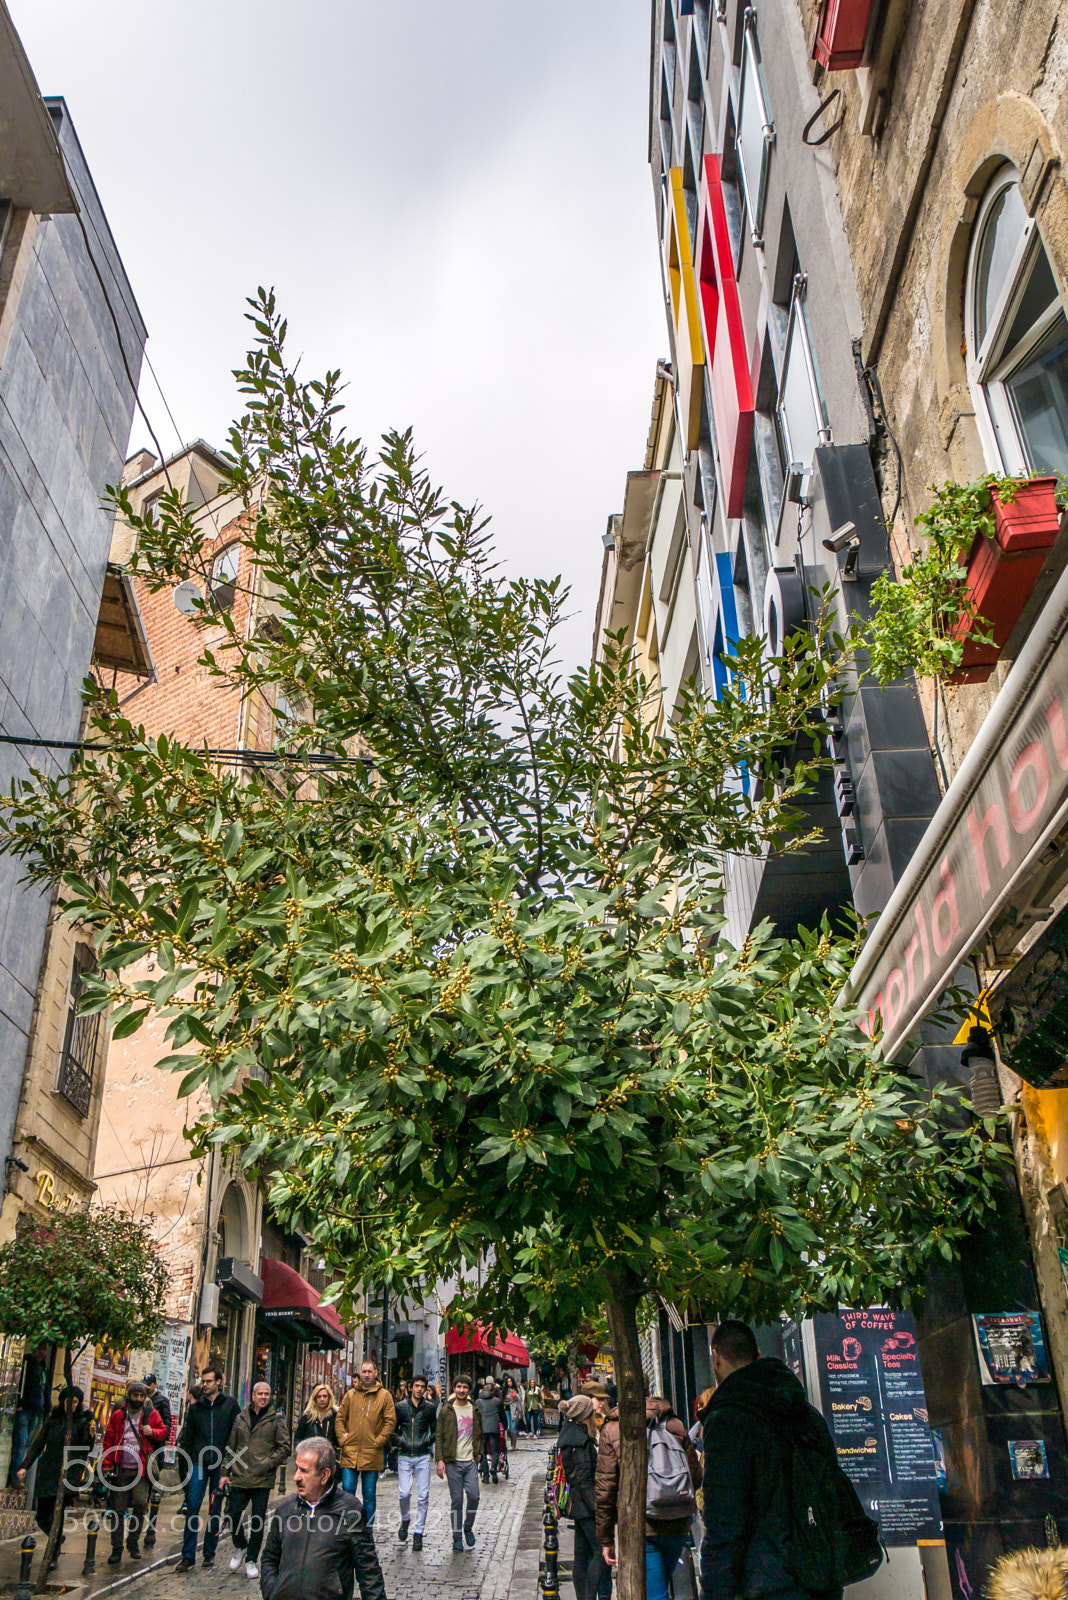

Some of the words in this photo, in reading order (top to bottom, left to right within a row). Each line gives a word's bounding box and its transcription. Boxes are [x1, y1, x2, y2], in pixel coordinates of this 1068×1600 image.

[841, 1312, 869, 1323] THIRD
[872, 1312, 896, 1321] WAVE
[845, 1320, 856, 1330] OF
[861, 1320, 894, 1330] COFFEE
[826, 1354, 842, 1362] Milk
[881, 1352, 917, 1362] Specialty
[827, 1362, 858, 1370] Classics
[831, 1402, 858, 1412] Bakery
[889, 1412, 913, 1421] Cakes
[836, 1447, 877, 1455] Sandwiches
